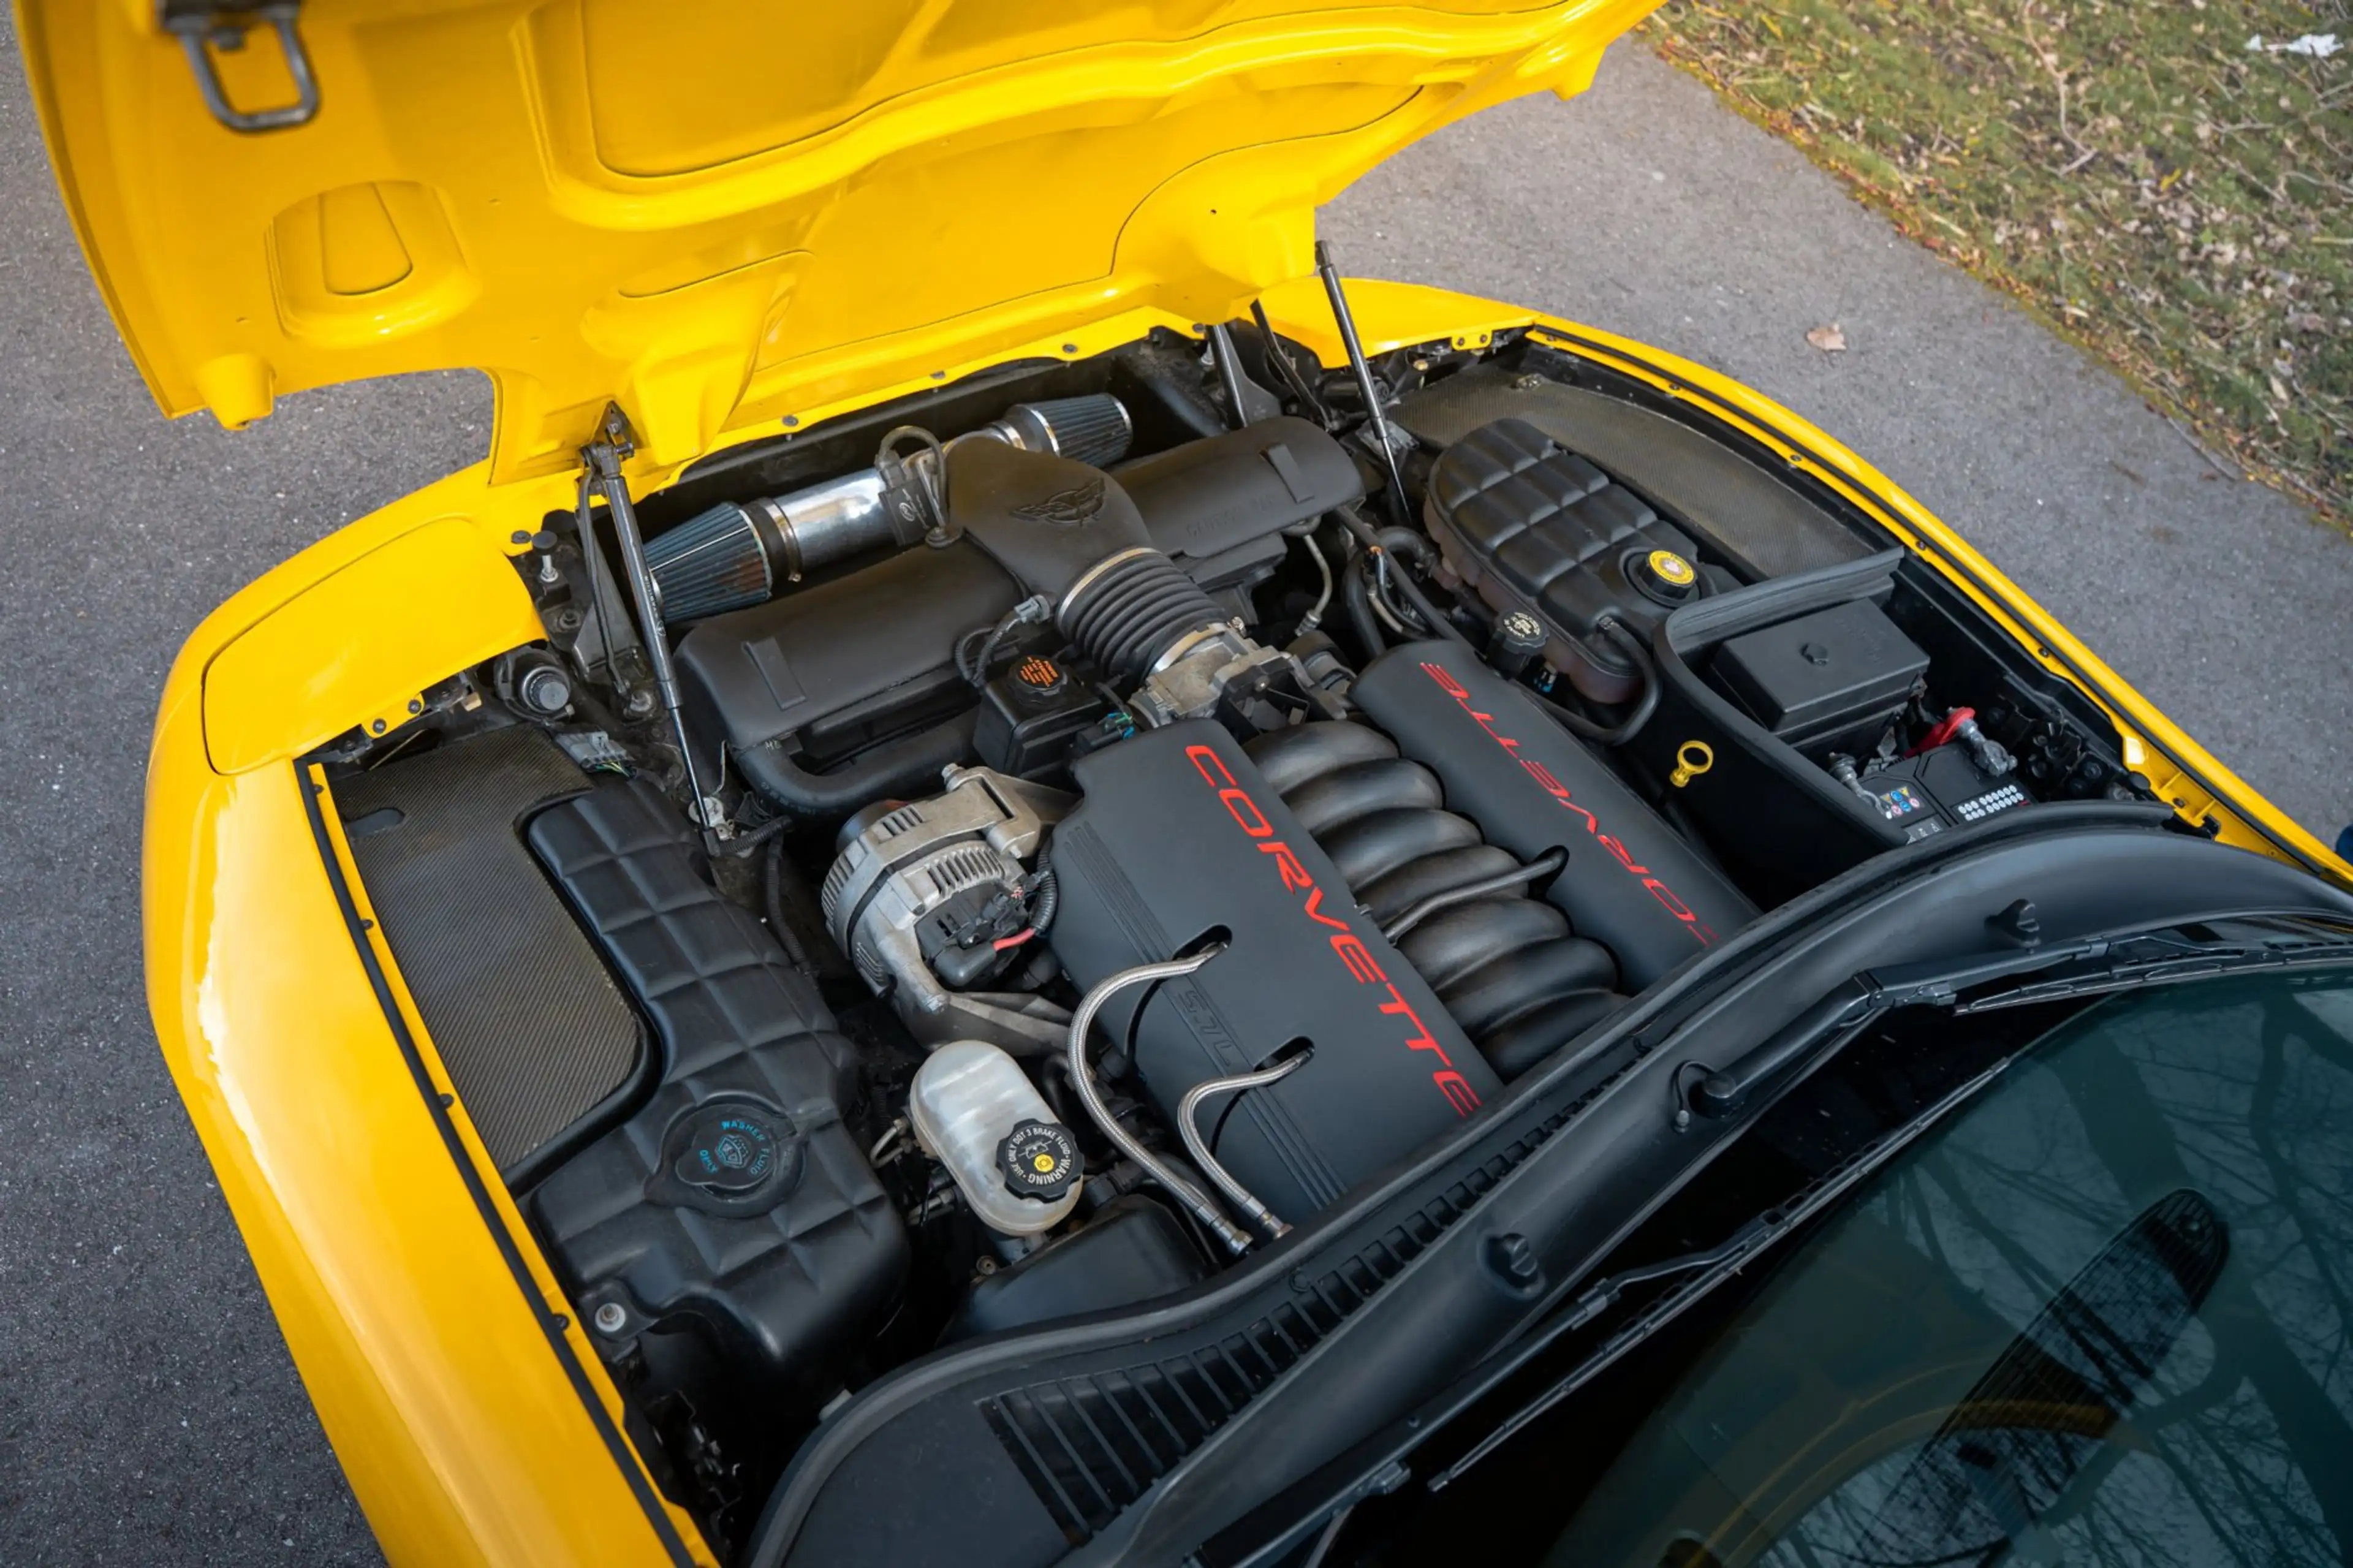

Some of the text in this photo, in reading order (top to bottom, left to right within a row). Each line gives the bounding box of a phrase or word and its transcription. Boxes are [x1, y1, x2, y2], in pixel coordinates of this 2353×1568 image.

[1185, 745, 1481, 1116] CORVETTE
[1013, 1132, 1026, 1145] DOT
[1033, 1127, 1056, 1140] BRAKE
[721, 1121, 765, 1141] WASHER
[750, 1148, 770, 1175] FLUID
[1008, 1144, 1017, 1162] ONLY
[1056, 1136, 1070, 1155] FLUID
[1011, 1162, 1024, 1176] USE
[1028, 1159, 1071, 1185] WARNING
